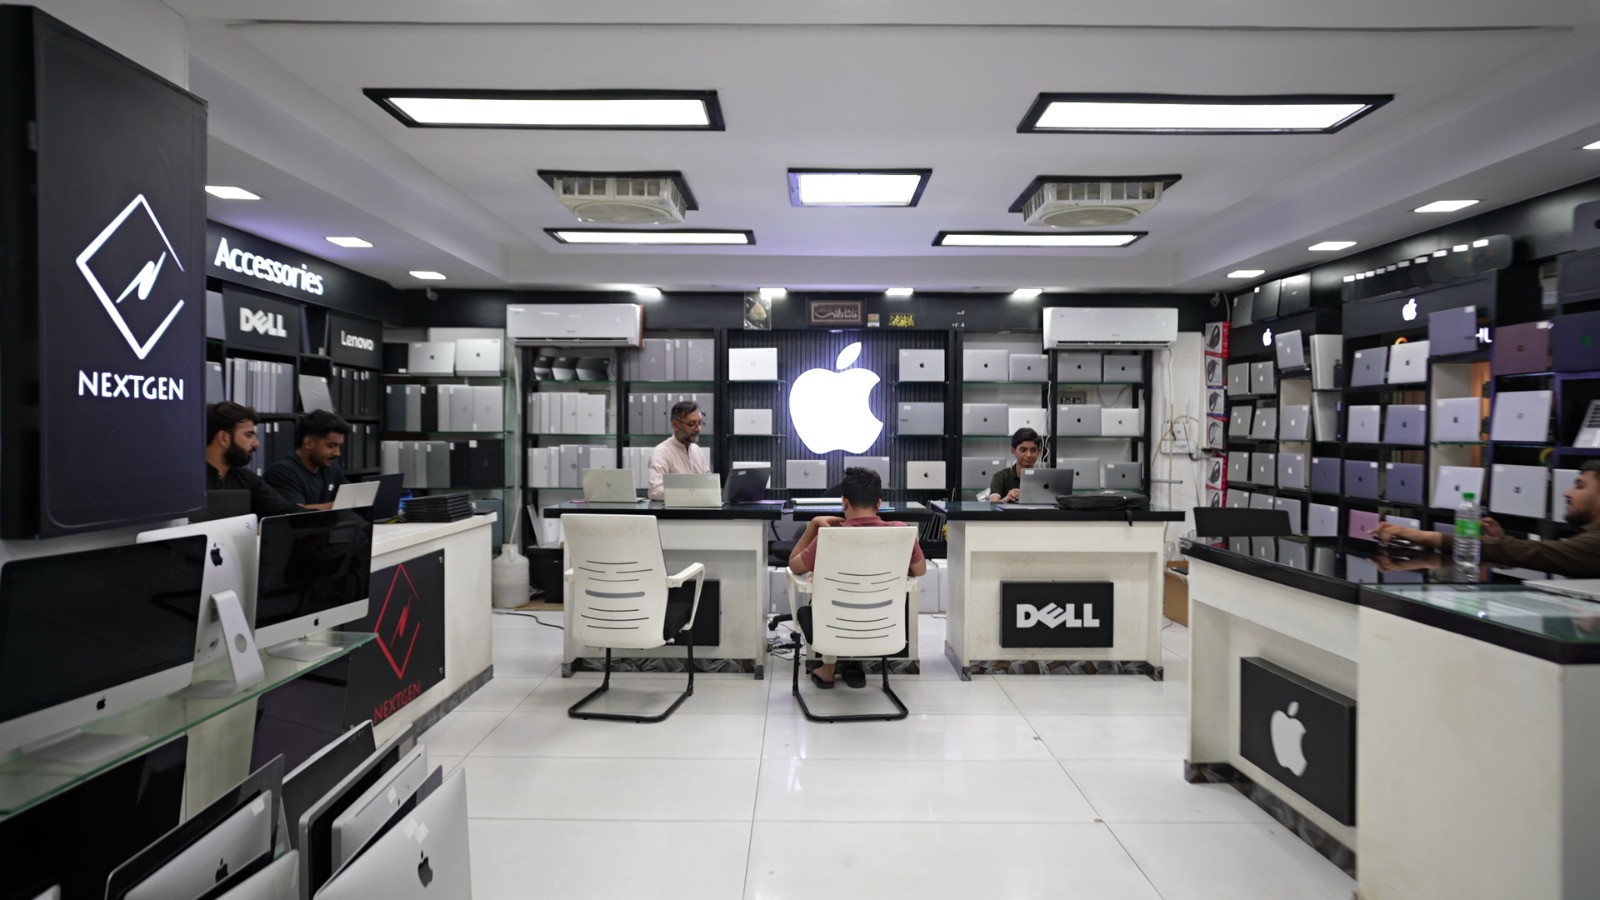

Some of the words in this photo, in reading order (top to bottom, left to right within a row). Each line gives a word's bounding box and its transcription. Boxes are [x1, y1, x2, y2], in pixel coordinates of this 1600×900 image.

[214, 237, 324, 295] Accessories
[239, 306, 287, 338] DELL
[340, 330, 375, 351] Lenovo
[78, 369, 184, 401] NEXTGEN
[1016, 602, 1100, 629] DELL
[373, 680, 421, 724] NEXTGEN
